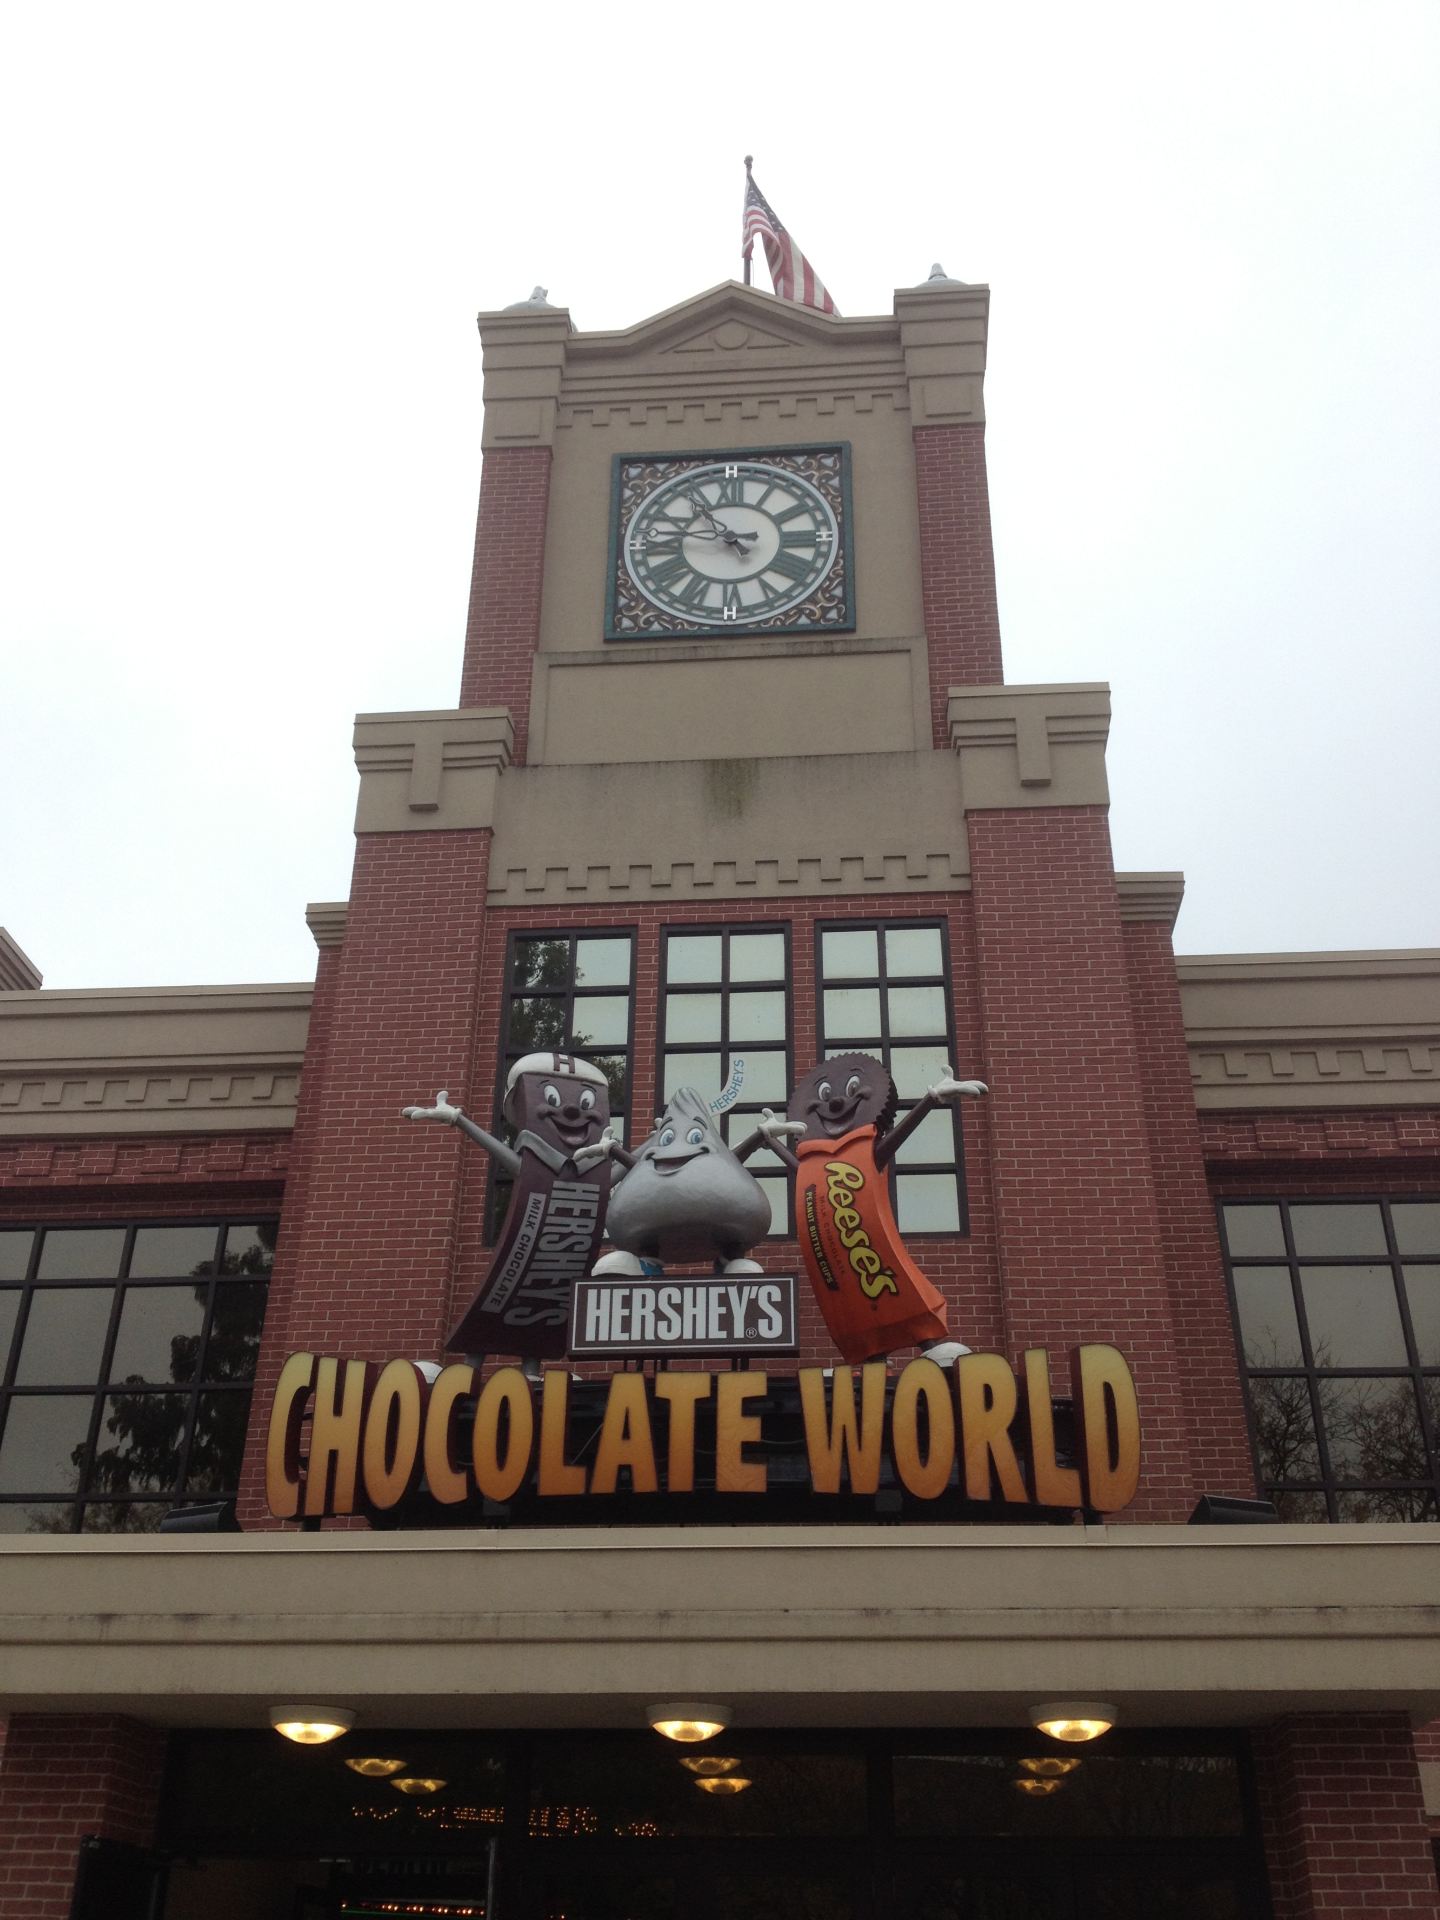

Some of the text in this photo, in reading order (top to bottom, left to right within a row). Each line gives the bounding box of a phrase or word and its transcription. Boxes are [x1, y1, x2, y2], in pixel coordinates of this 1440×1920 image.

[725, 465, 738, 479] H
[723, 605, 737, 620] H
[552, 1053, 576, 1074] H
[491, 1198, 542, 1307] MILK CHOCOLATE
[806, 1191, 833, 1284] PEANUT BUTTER CUPS
[585, 1284, 783, 1342] HERSHEY'S
[266, 1343, 1142, 1519] CHOCOLATE WORLD
